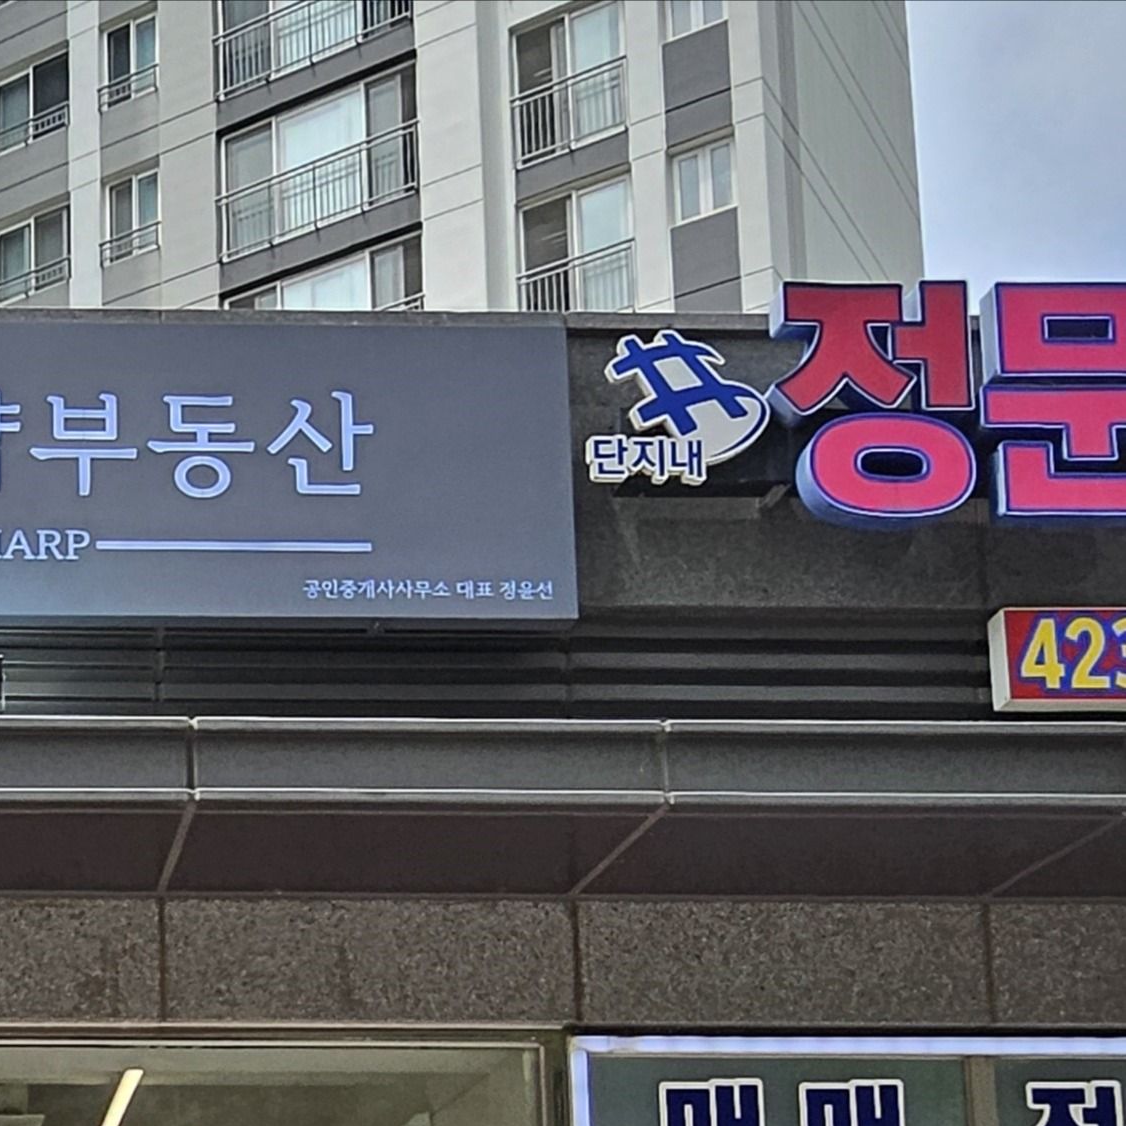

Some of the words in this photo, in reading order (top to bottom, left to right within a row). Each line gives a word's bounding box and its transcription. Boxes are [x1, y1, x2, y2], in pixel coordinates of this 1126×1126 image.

[590, 435, 705, 481] 단지내
[302, 579, 451, 599] 공인중개사사무소
[456, 580, 494, 600] 대표
